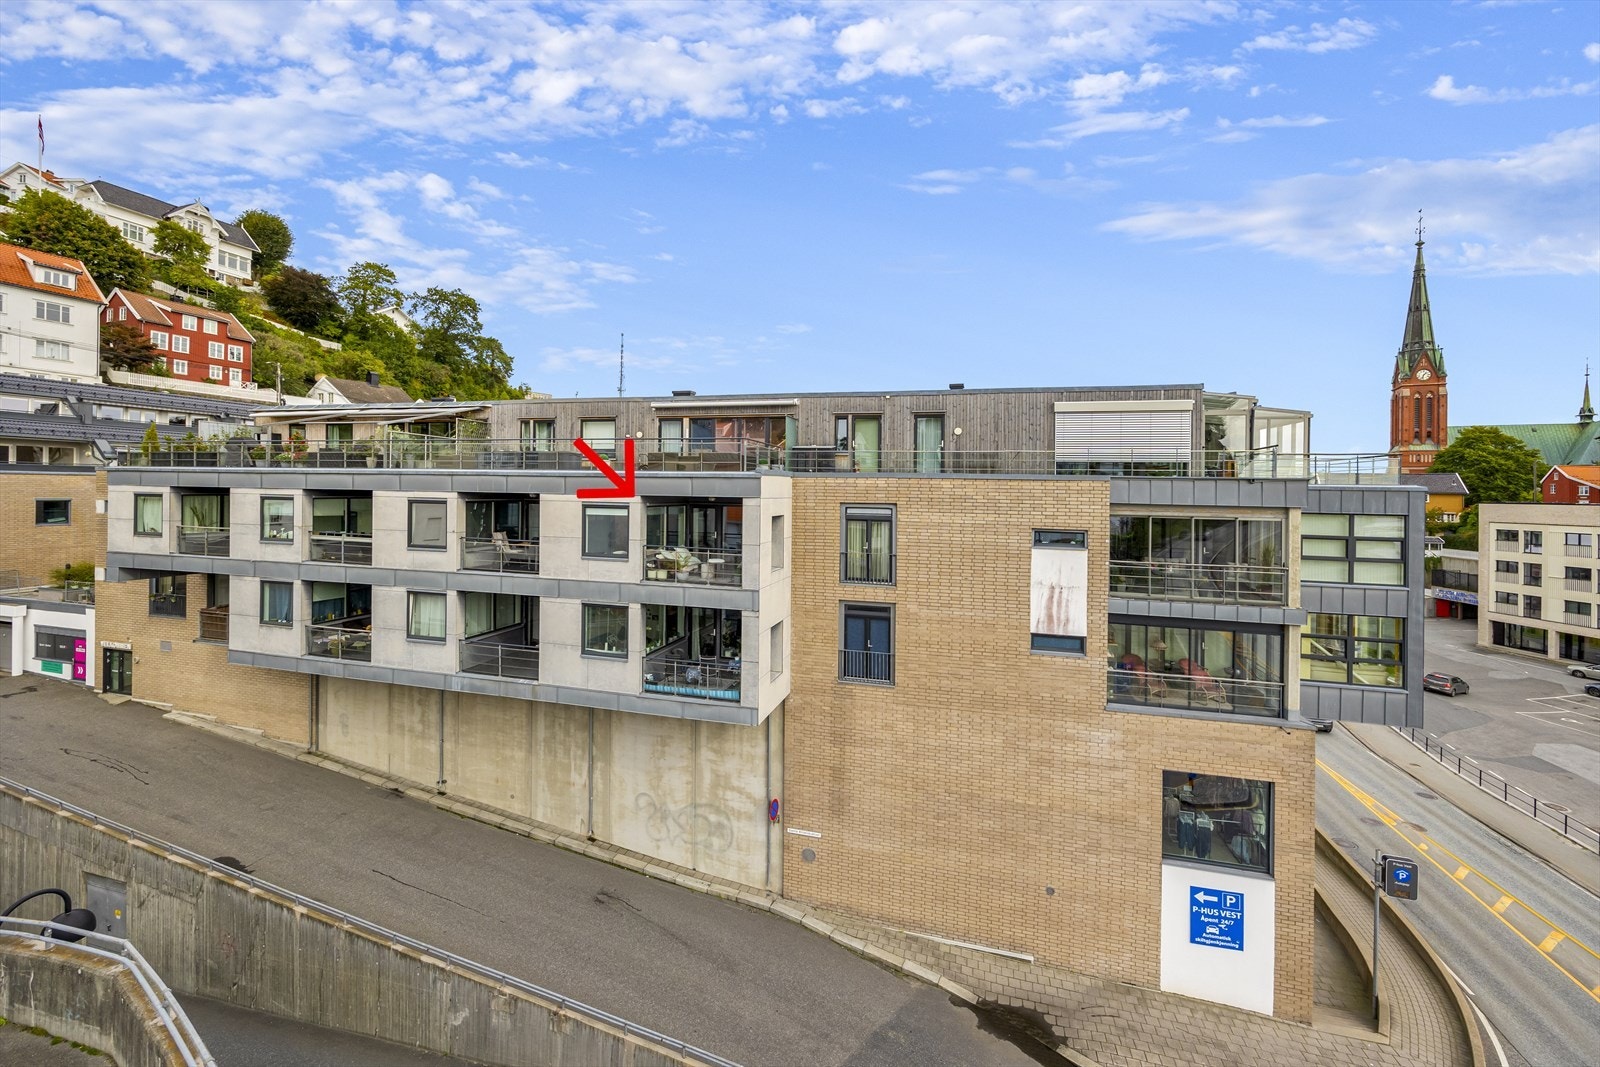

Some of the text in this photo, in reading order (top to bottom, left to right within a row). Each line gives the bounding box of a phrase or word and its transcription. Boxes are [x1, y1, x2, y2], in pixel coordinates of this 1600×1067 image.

[1399, 872, 1407, 880] P
[1226, 895, 1237, 907] P
[1192, 905, 1242, 919] P-HUS VEST
